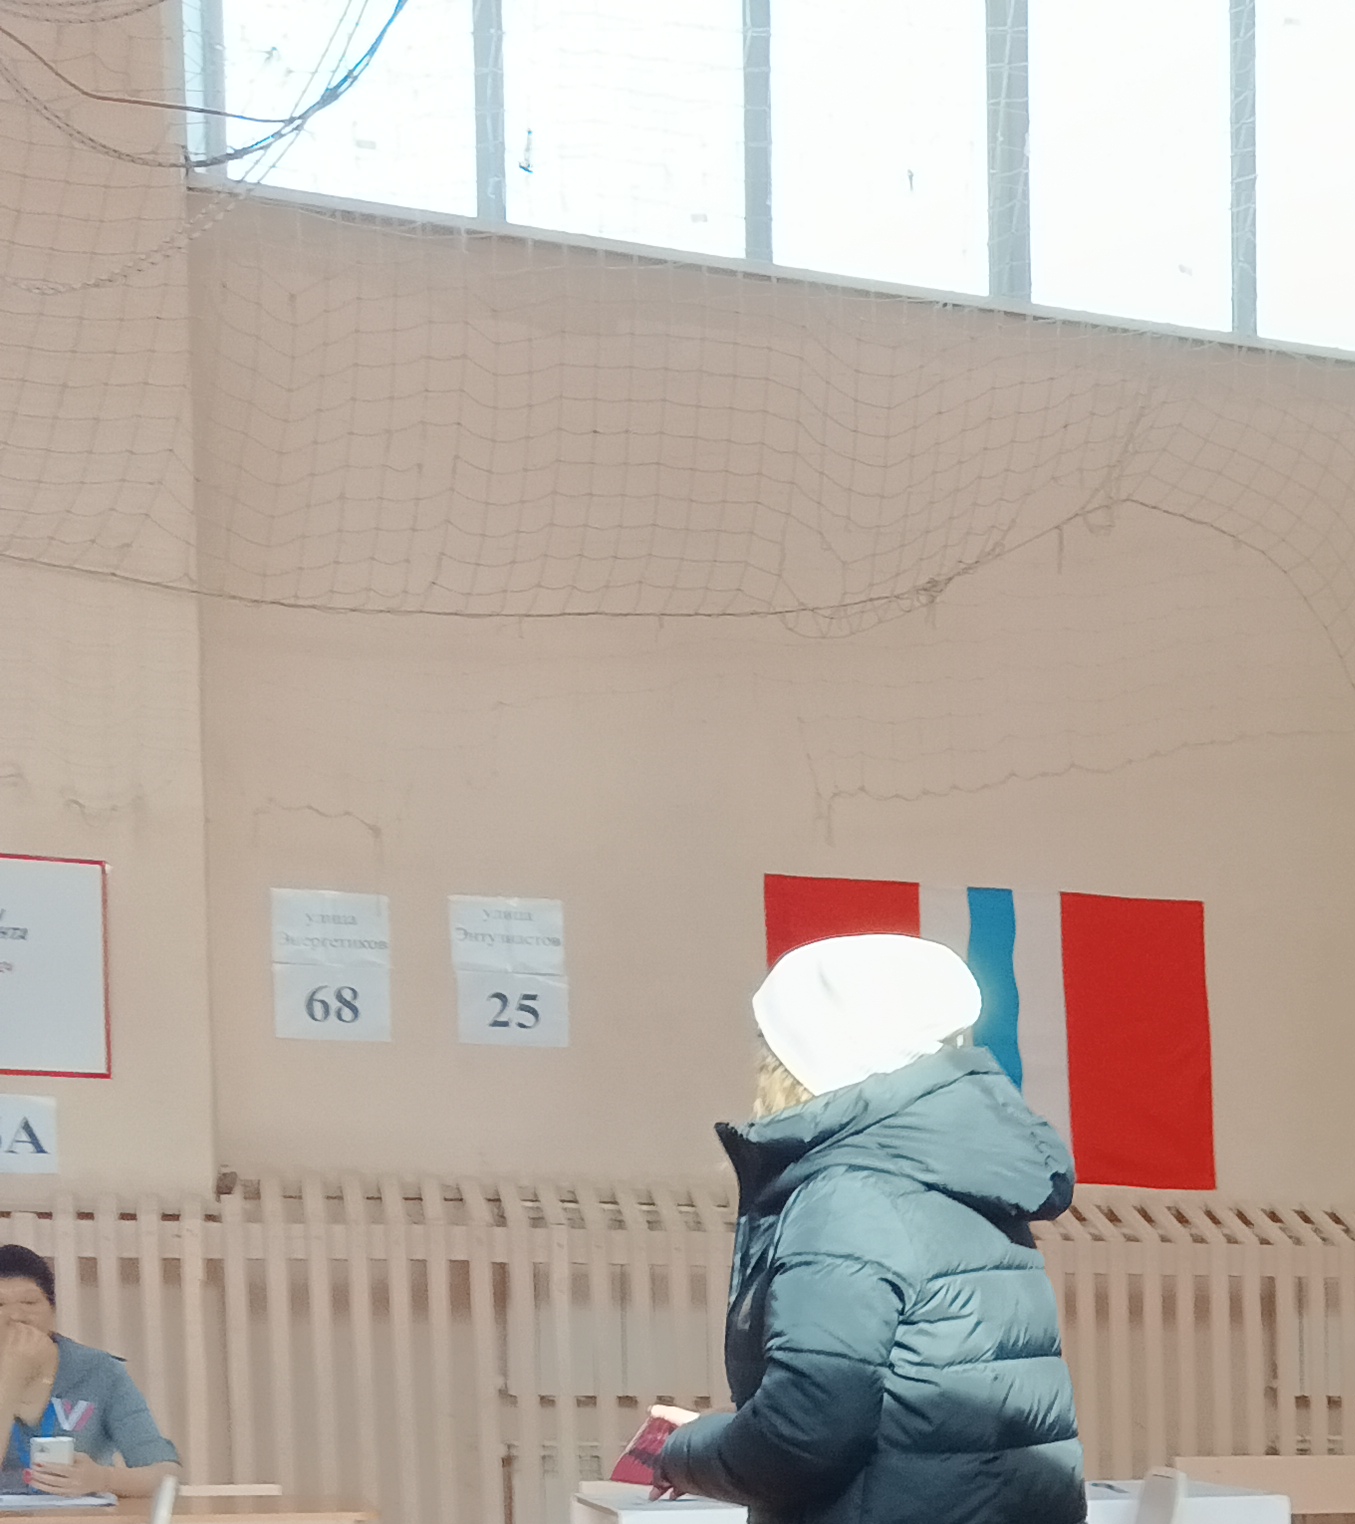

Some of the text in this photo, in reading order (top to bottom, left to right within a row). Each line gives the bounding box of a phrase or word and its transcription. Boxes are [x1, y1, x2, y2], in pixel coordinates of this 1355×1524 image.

[305, 985, 360, 1023] 68
[487, 992, 541, 1029] 25
[0, 1116, 51, 1154] А
